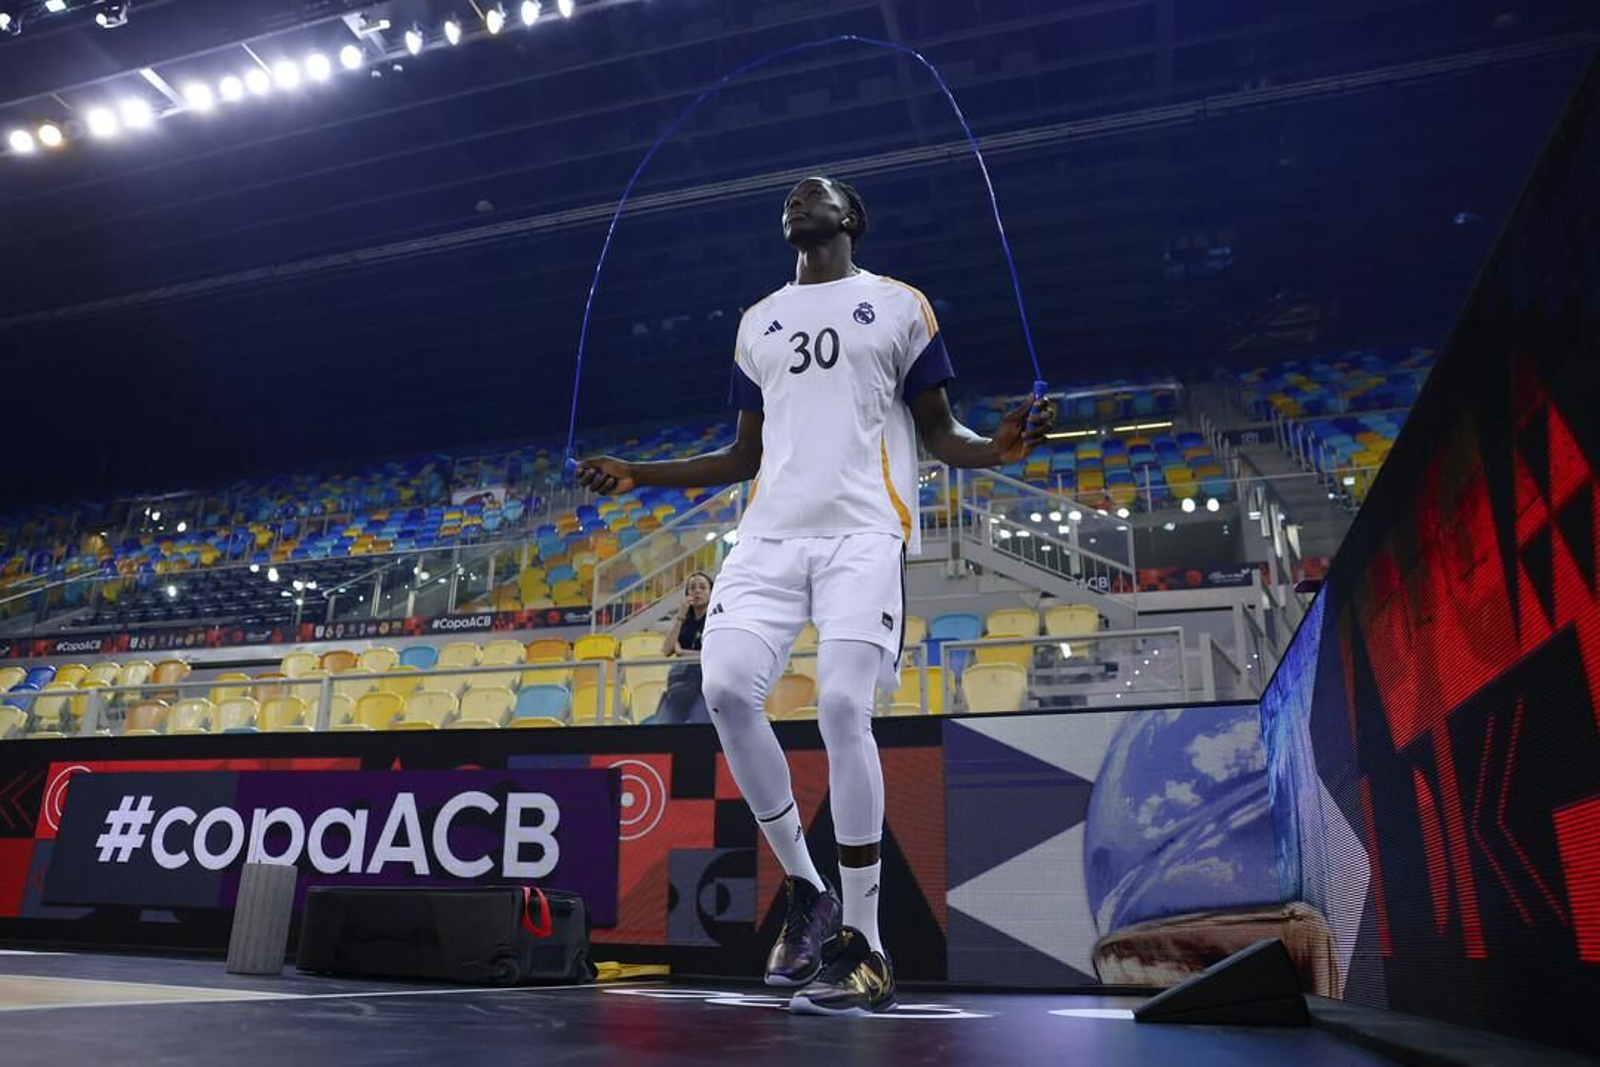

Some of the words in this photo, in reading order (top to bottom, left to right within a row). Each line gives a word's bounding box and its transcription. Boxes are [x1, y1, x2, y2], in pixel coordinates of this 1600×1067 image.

[789, 327, 840, 374] 30
[432, 615, 491, 631] #CopaACB
[95, 791, 561, 878] #copaACB
